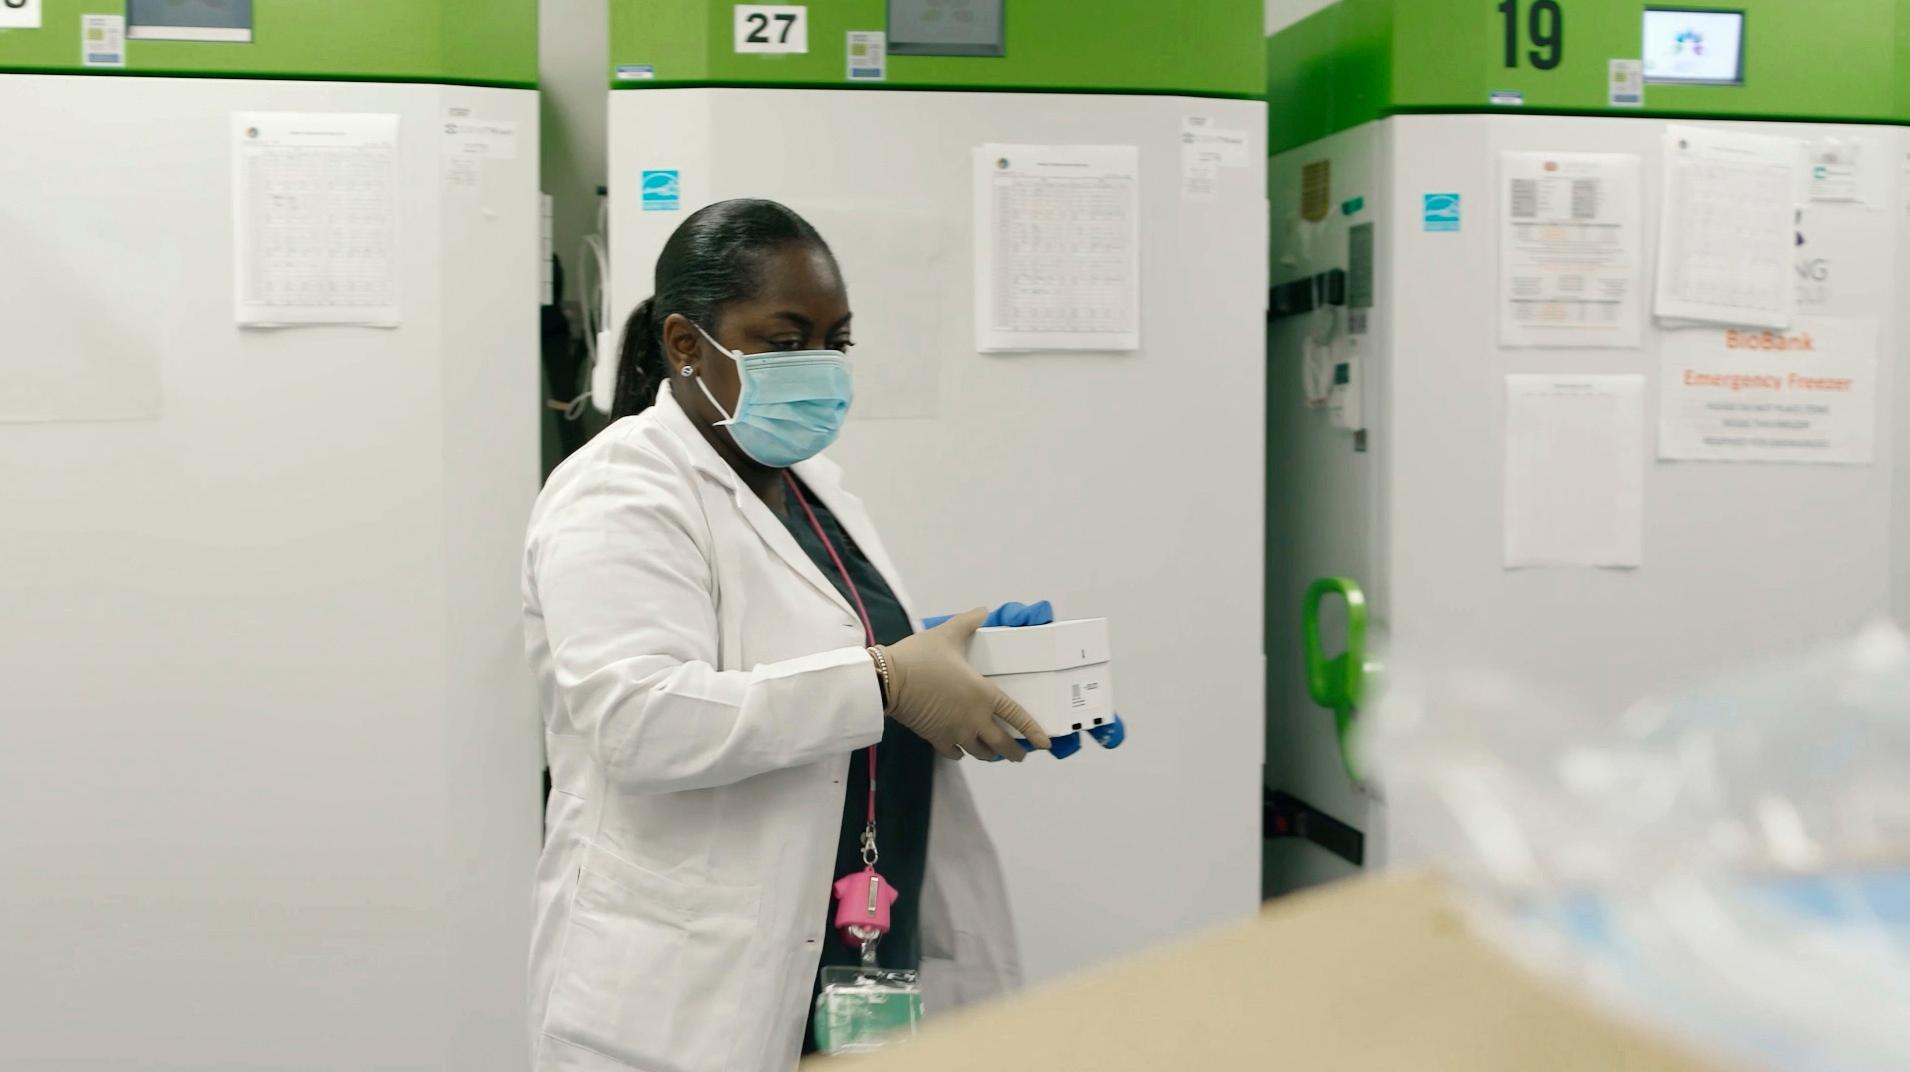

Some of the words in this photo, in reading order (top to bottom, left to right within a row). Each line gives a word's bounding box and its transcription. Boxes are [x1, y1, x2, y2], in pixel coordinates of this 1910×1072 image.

[745, 13, 797, 43] 27
[1498, 0, 1562, 70] 19
[1726, 329, 1815, 350] BioBank
[1683, 369, 1781, 391] Emergency
[1787, 373, 1853, 391] Freezer
